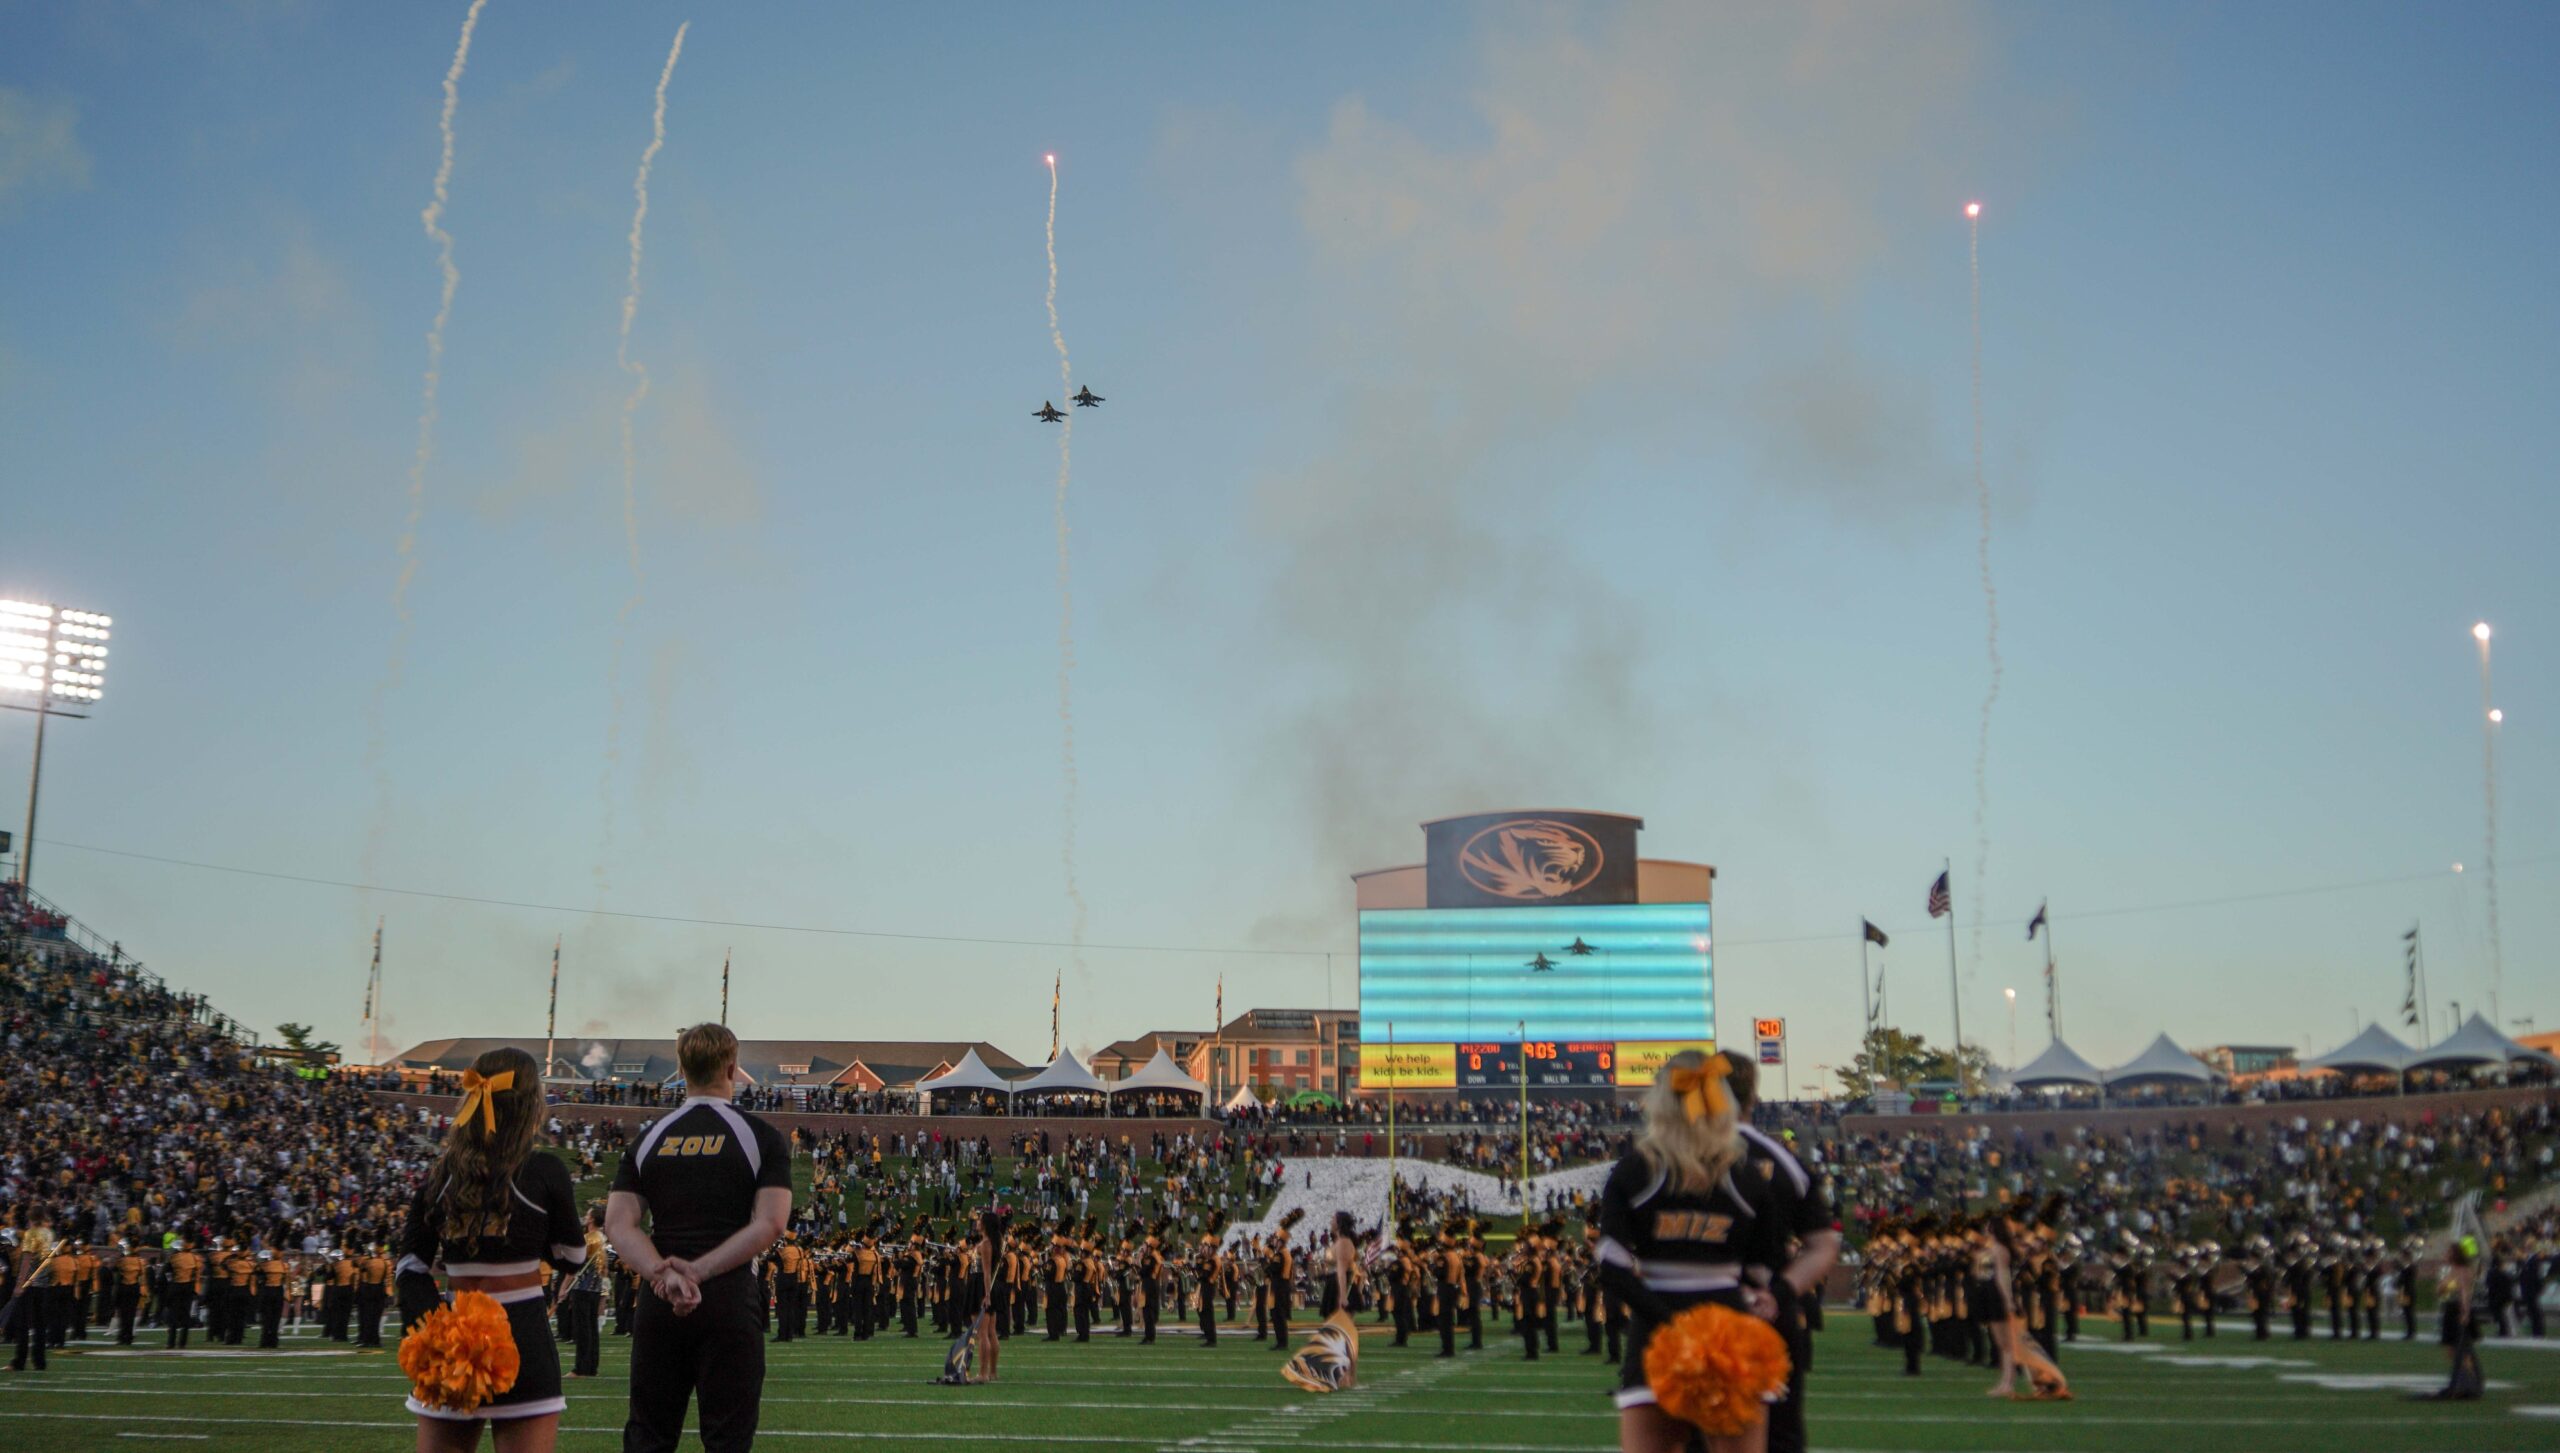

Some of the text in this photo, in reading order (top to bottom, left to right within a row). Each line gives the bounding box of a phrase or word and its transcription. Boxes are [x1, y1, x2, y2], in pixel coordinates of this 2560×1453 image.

[1758, 1020, 1780, 1037] 40
[1461, 1043, 1500, 1054] MIZZOU
[1385, 1054, 1431, 1064] We help
[1598, 1052, 1611, 1069] 0
[1642, 1052, 1661, 1061] We
[1469, 1054, 1482, 1070] 0
[1373, 1066, 1396, 1076] kids
[1399, 1066, 1414, 1076] be
[1630, 1064, 1654, 1074] kids
[1467, 1075, 1487, 1084] DOWN
[1543, 1074, 1570, 1084] BALL ON
[657, 1134, 725, 1157] ZOU
[1654, 1210, 1734, 1244] MIZ
